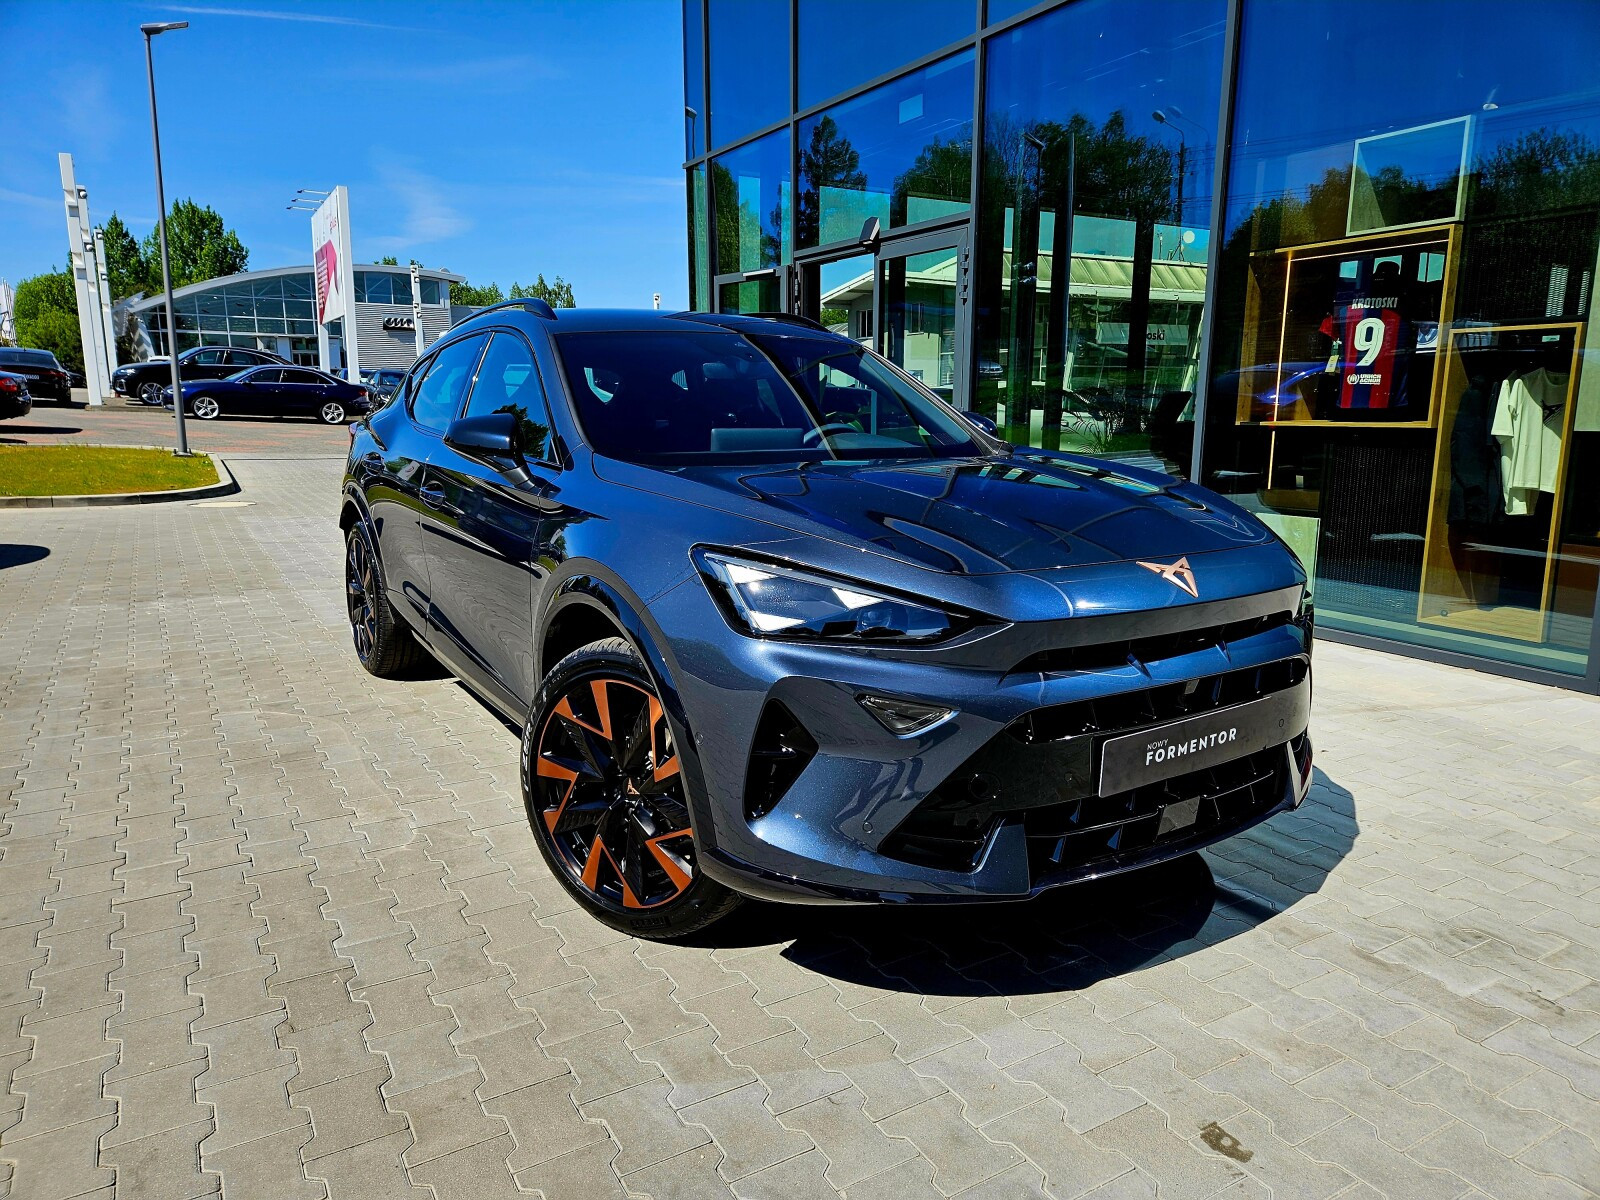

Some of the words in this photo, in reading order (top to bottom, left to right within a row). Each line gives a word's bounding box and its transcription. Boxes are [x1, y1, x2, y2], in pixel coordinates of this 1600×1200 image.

[1351, 297, 1398, 309] KROTOSKI
[1354, 318, 1385, 366] 9
[1145, 728, 1236, 766] FORMENTOR
[1147, 739, 1168, 750] NOWY
